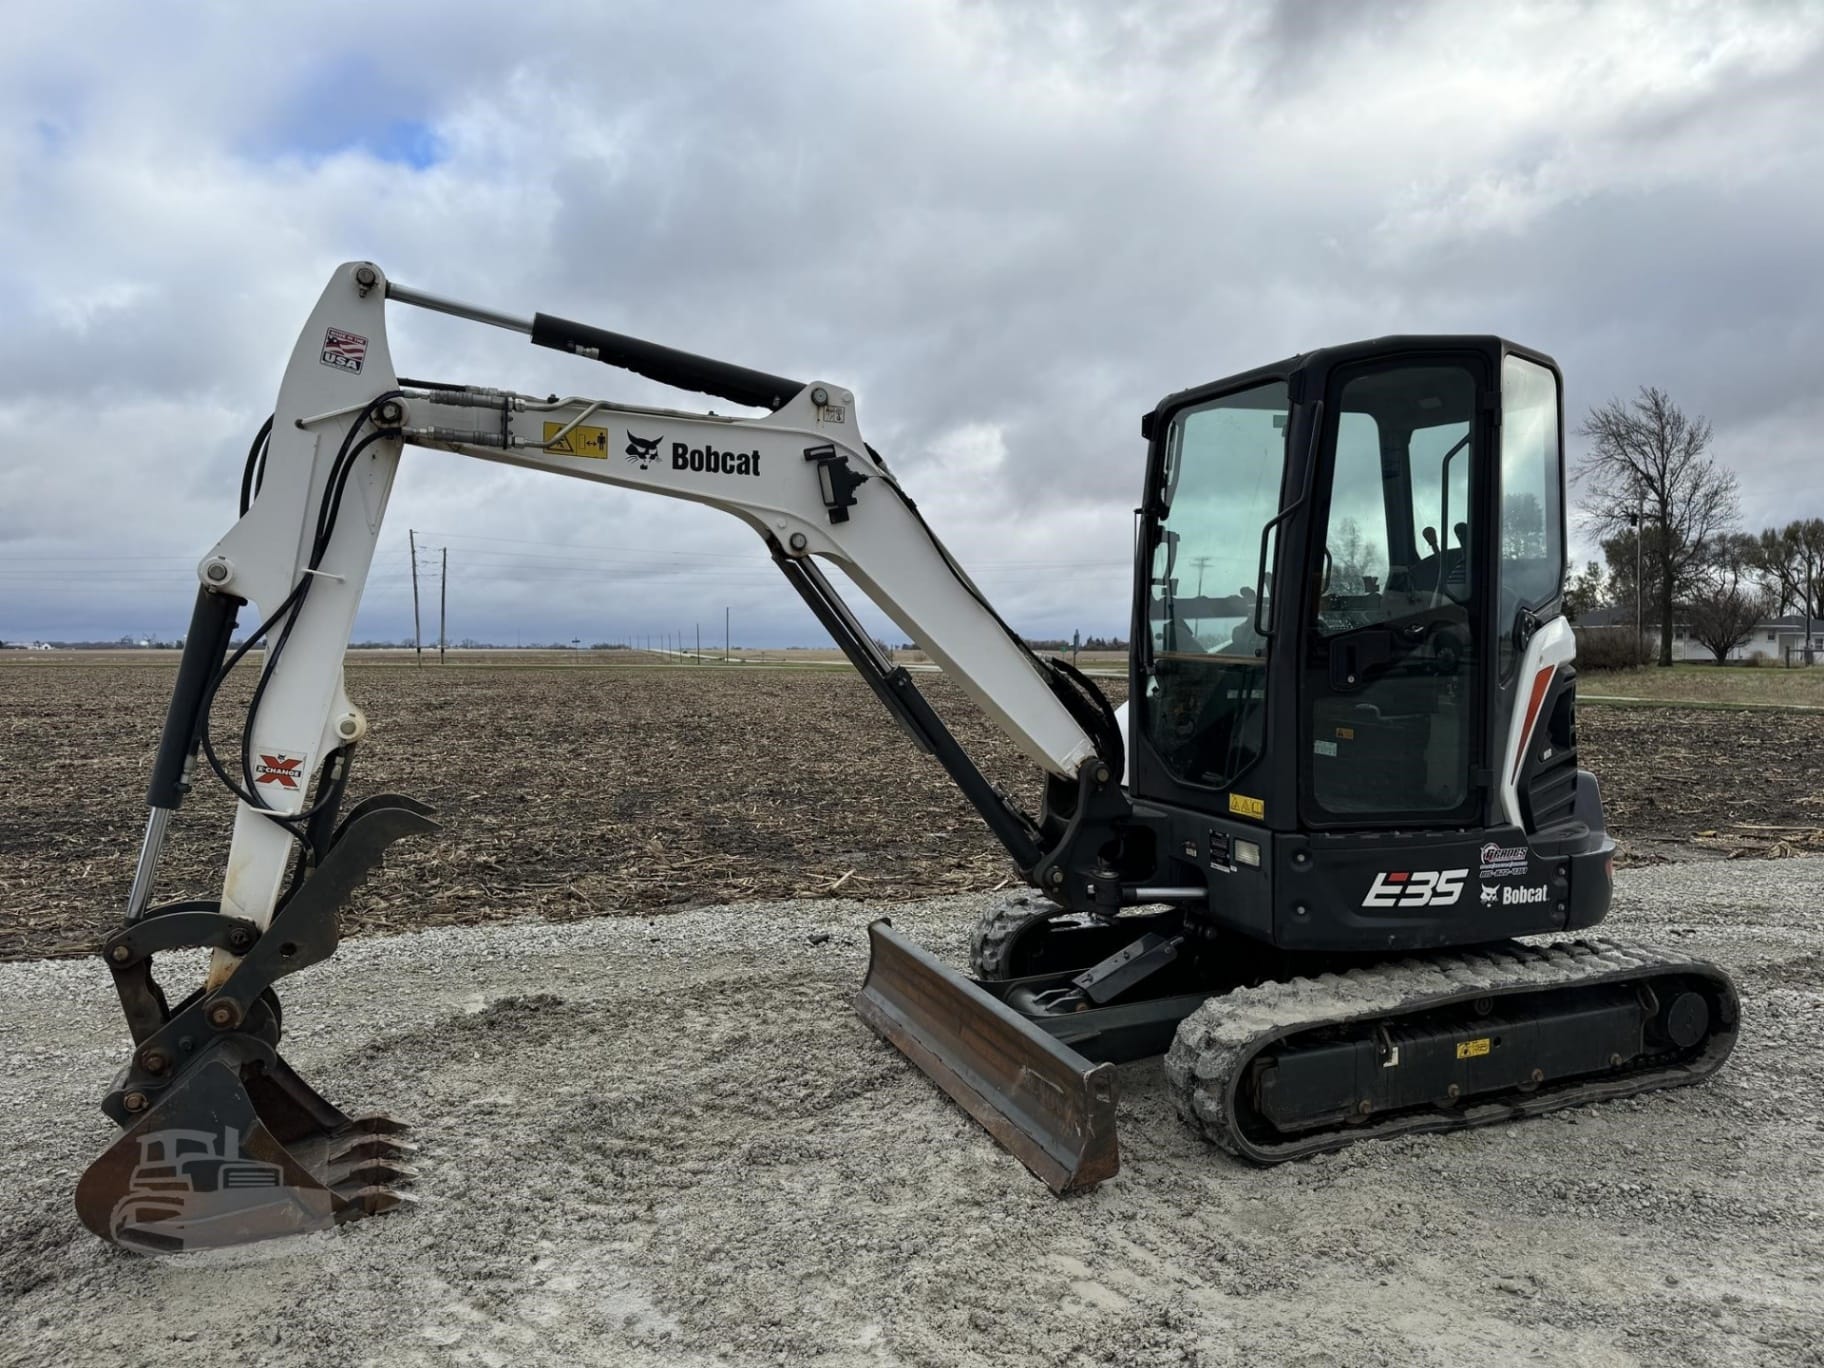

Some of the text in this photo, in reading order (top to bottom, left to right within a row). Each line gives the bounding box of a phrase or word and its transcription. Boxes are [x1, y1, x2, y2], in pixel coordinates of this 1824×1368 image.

[324, 353, 358, 369] USA
[672, 443, 761, 477] Bobcat
[1361, 868, 1470, 907] E35
[1503, 885, 1548, 905] Bobcat
